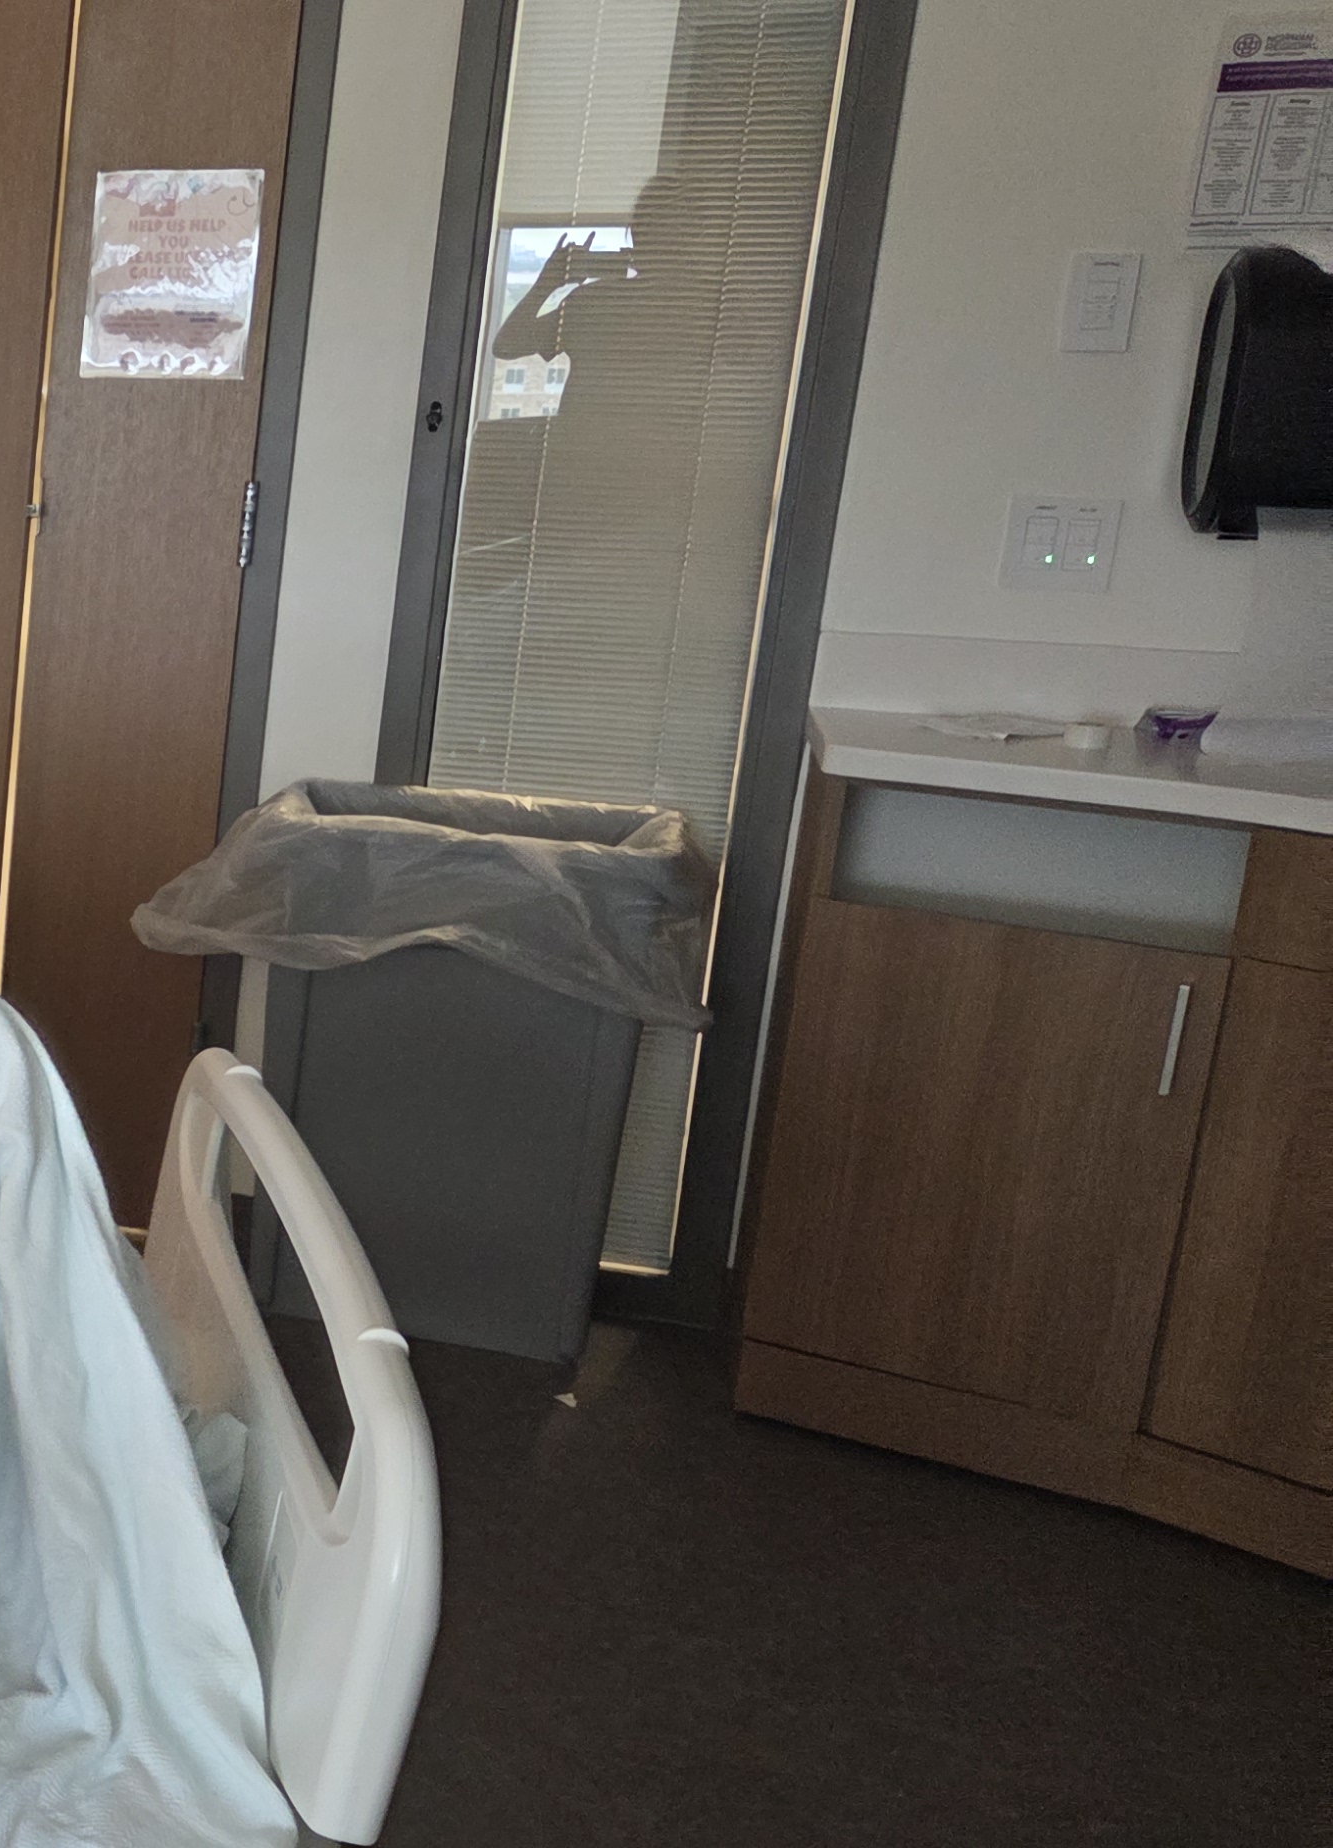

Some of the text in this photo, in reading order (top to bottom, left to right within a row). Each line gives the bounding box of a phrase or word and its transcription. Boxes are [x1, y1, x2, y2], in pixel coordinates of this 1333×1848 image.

[128, 219, 227, 233] HELP US HELP
[159, 235, 189, 250] YOU
